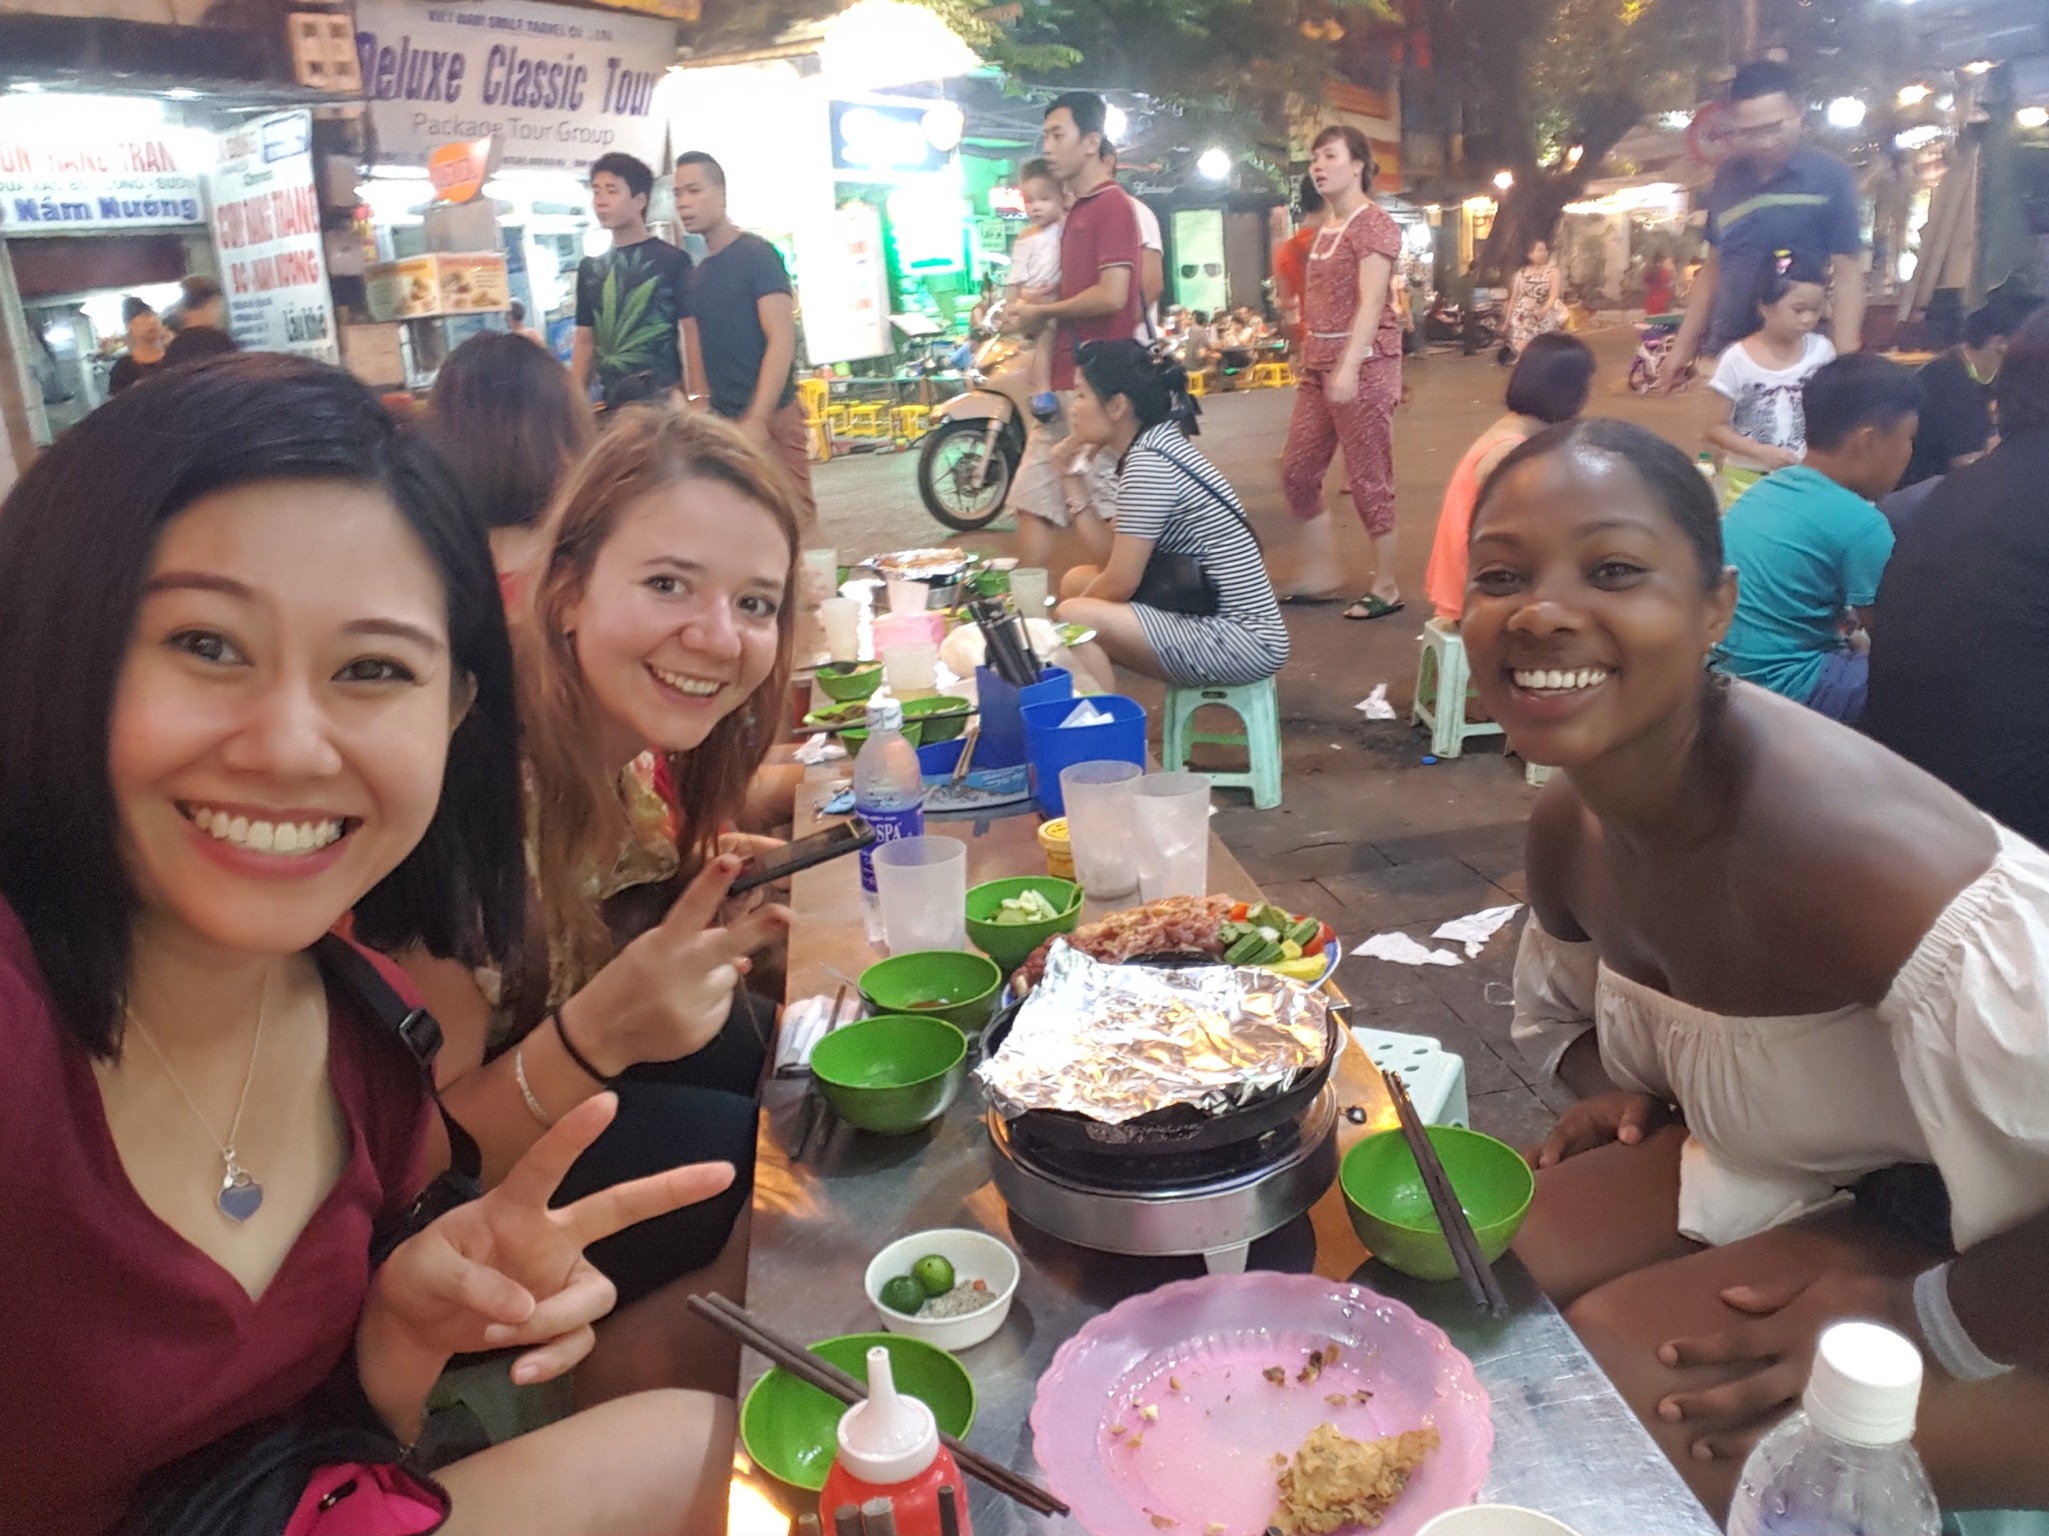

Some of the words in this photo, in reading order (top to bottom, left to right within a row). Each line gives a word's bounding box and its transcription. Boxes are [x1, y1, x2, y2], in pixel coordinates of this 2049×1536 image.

[355, 31, 466, 103] Deluxe
[482, 44, 588, 111] Classic
[413, 112, 504, 138] Package
[508, 117, 553, 141] Tour
[557, 120, 615, 146] Group
[876, 823, 902, 843] SPA
